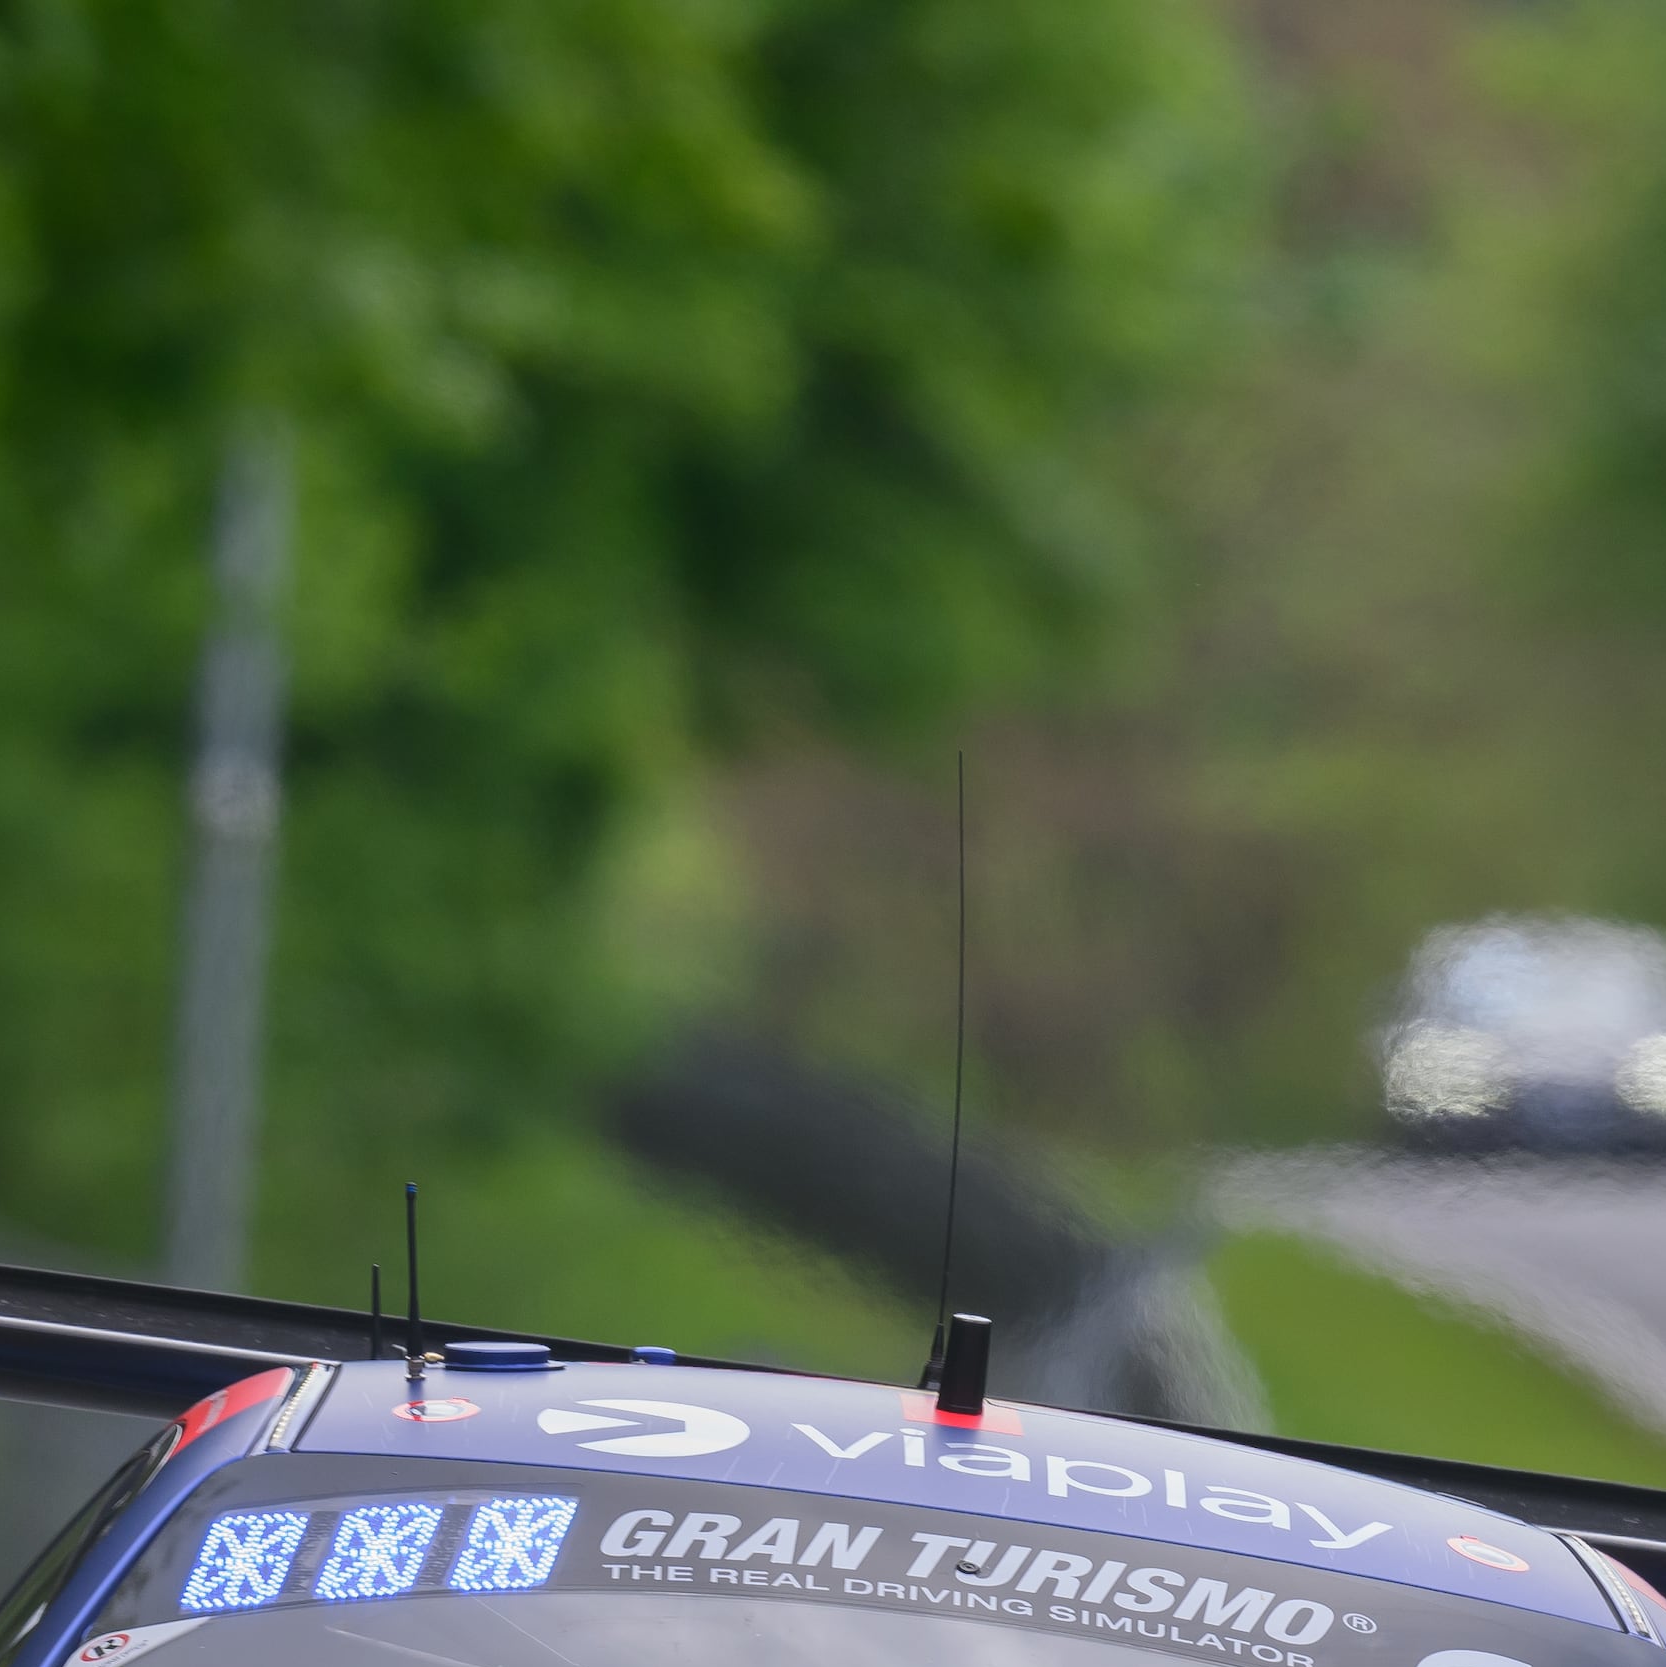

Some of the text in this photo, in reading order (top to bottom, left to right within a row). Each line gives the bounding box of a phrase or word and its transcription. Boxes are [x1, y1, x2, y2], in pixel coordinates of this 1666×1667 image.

[790, 1422, 1395, 1549] viaplay
[599, 1509, 884, 1570] GRAN
[602, 1564, 694, 1582] THE
[709, 1568, 830, 1591] REAL
[843, 1577, 1035, 1616] DRIVING
